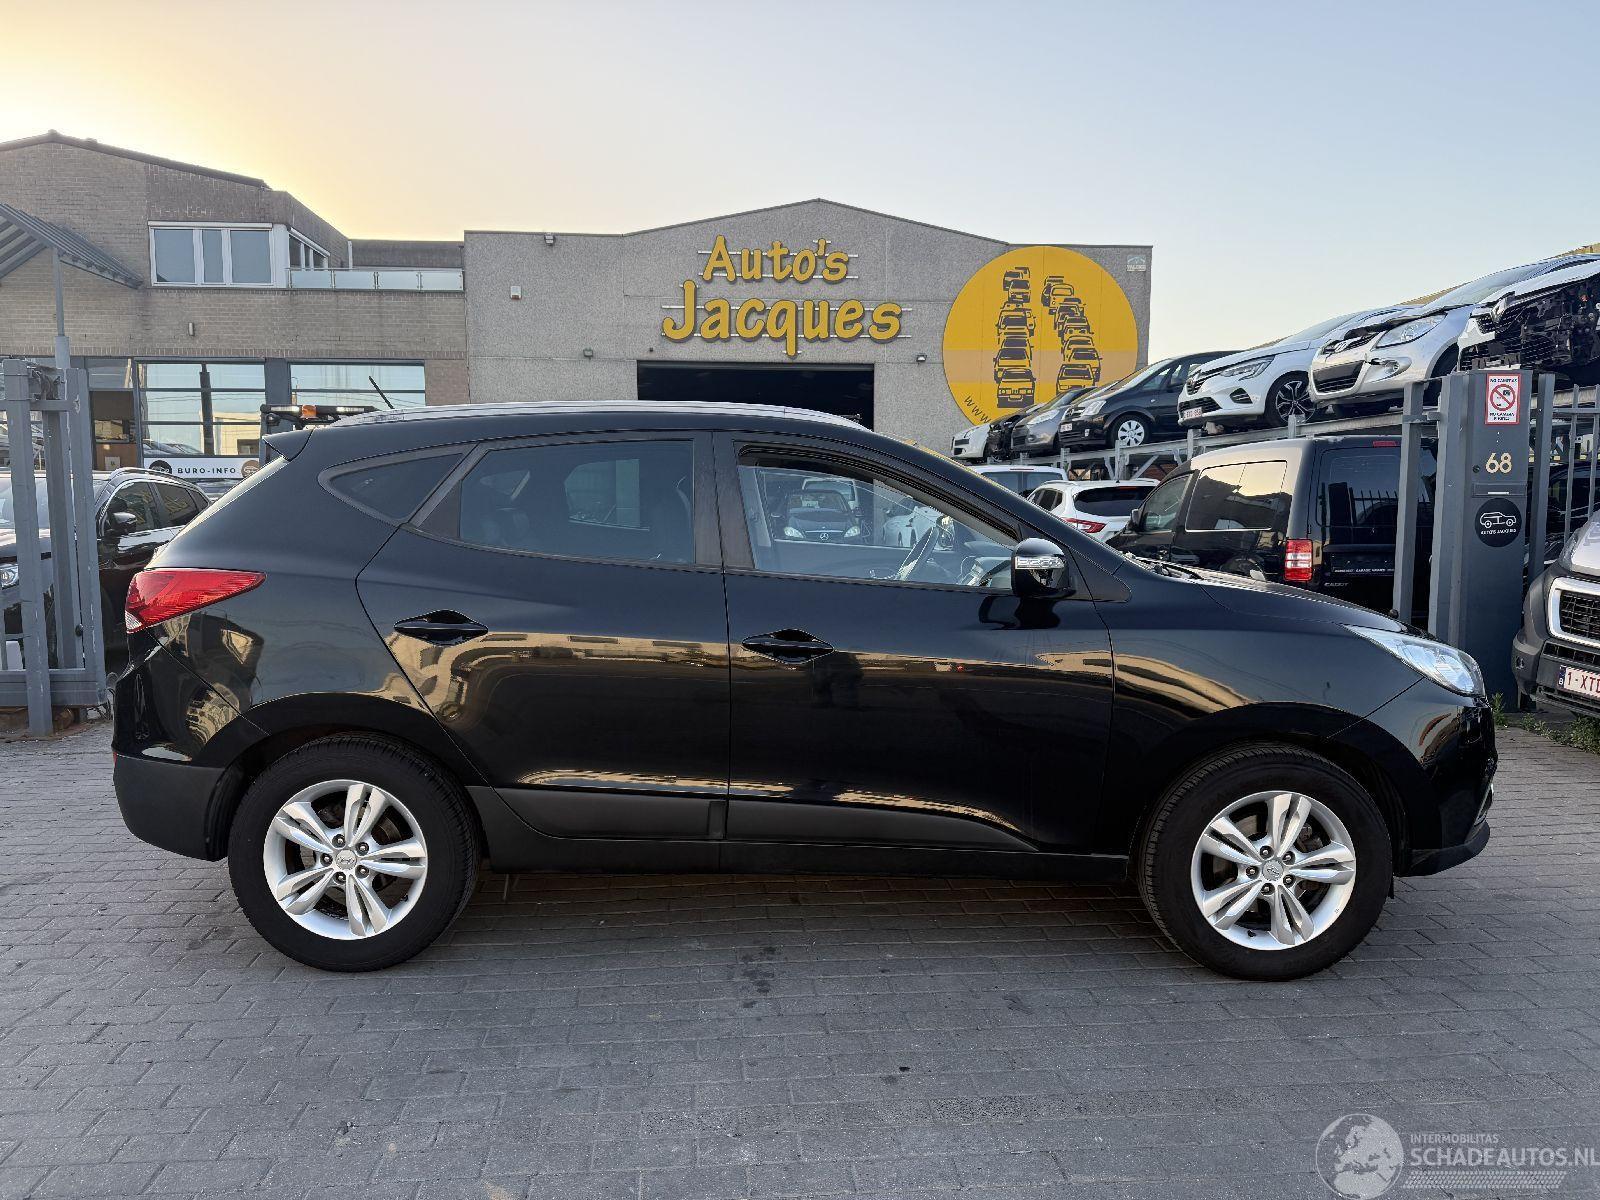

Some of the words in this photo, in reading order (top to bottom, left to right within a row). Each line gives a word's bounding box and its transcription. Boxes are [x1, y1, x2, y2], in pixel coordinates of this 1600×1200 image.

[703, 235, 849, 282] Auto's
[662, 280, 902, 357] Jacques
[1485, 452, 1512, 473] 68
